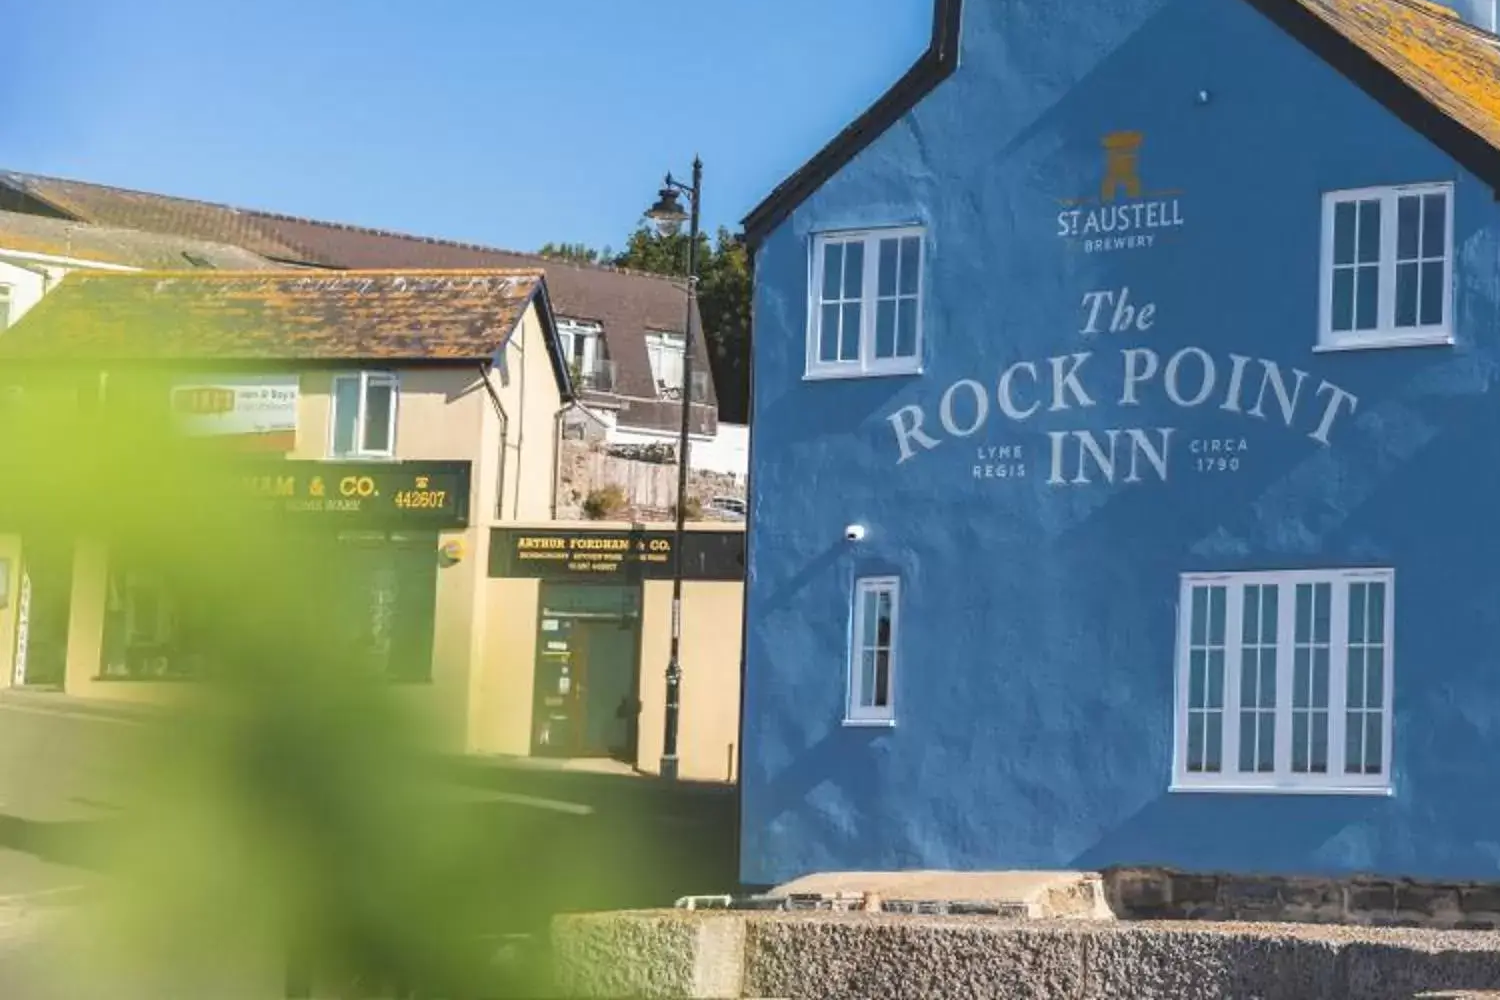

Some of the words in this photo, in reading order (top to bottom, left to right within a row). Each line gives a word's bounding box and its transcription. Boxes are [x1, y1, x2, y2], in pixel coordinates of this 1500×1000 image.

[1084, 200, 1184, 233] AUSTELL
[1084, 235, 1155, 253] BREWERY
[1079, 286, 1157, 334] The
[886, 351, 1097, 464] ROCK
[1118, 346, 1358, 447] POINT
[977, 445, 1023, 459] LYME
[1190, 438, 1248, 453] CIRCA
[1045, 427, 1176, 485] INN
[973, 464, 1026, 478] REGIS
[1198, 458, 1239, 473] 1790
[340, 476, 380, 497] CO.
[517, 537, 565, 549] ARTHUR
